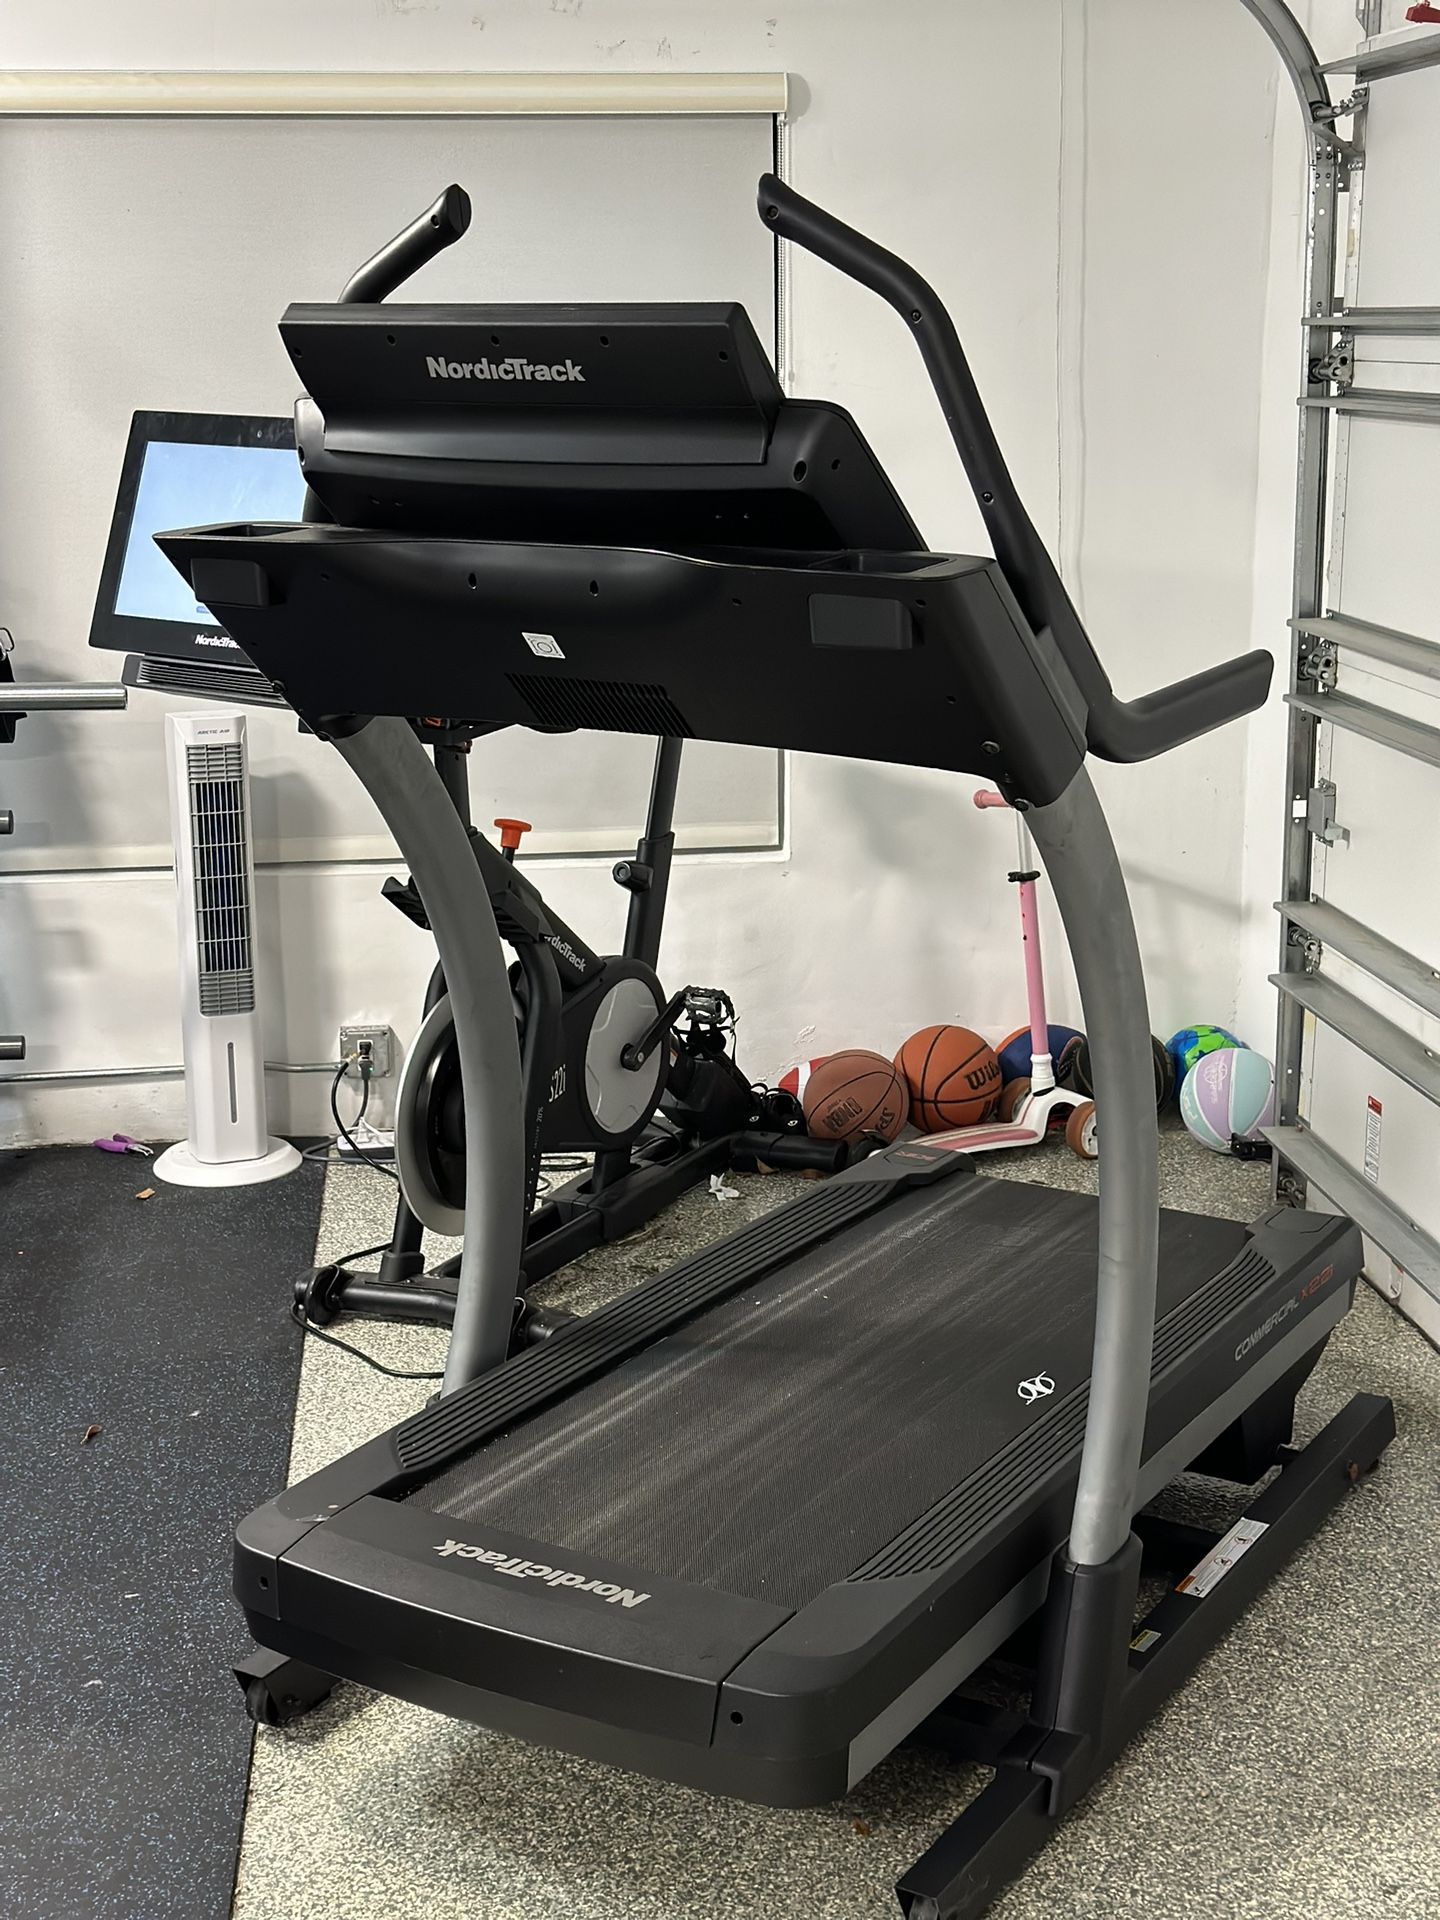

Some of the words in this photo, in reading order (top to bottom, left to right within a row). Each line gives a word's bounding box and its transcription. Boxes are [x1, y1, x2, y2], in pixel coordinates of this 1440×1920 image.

[425, 356, 586, 382] NordicTrack
[1234, 1296, 1300, 1361] COMMERCIAL
[432, 1539, 652, 1609] NordicTrack
